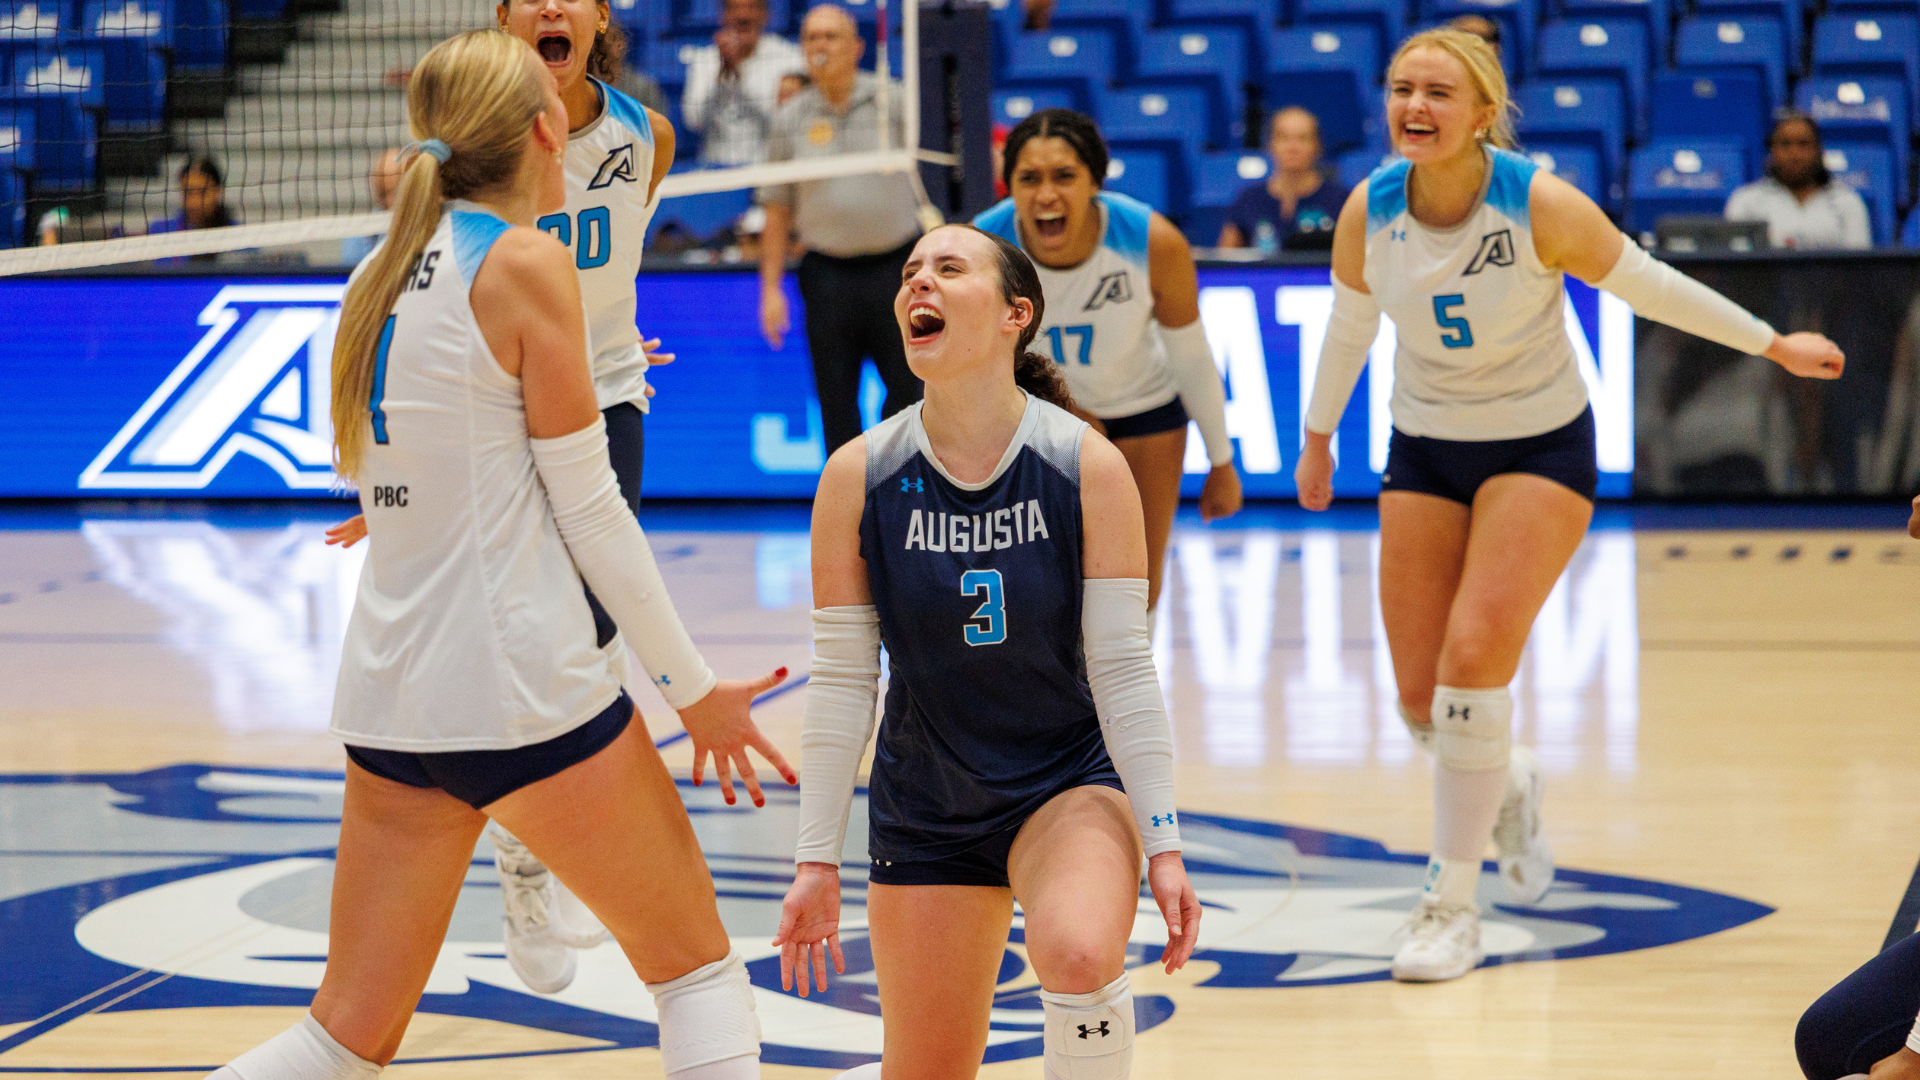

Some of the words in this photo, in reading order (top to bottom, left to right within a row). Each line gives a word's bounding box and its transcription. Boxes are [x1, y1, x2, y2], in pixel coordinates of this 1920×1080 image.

[1045, 324, 1094, 366] 17
[1432, 293, 1474, 349] 5
[374, 485, 408, 507] PBC
[904, 499, 1049, 553] AUGUSTA
[961, 568, 1008, 647] 3
